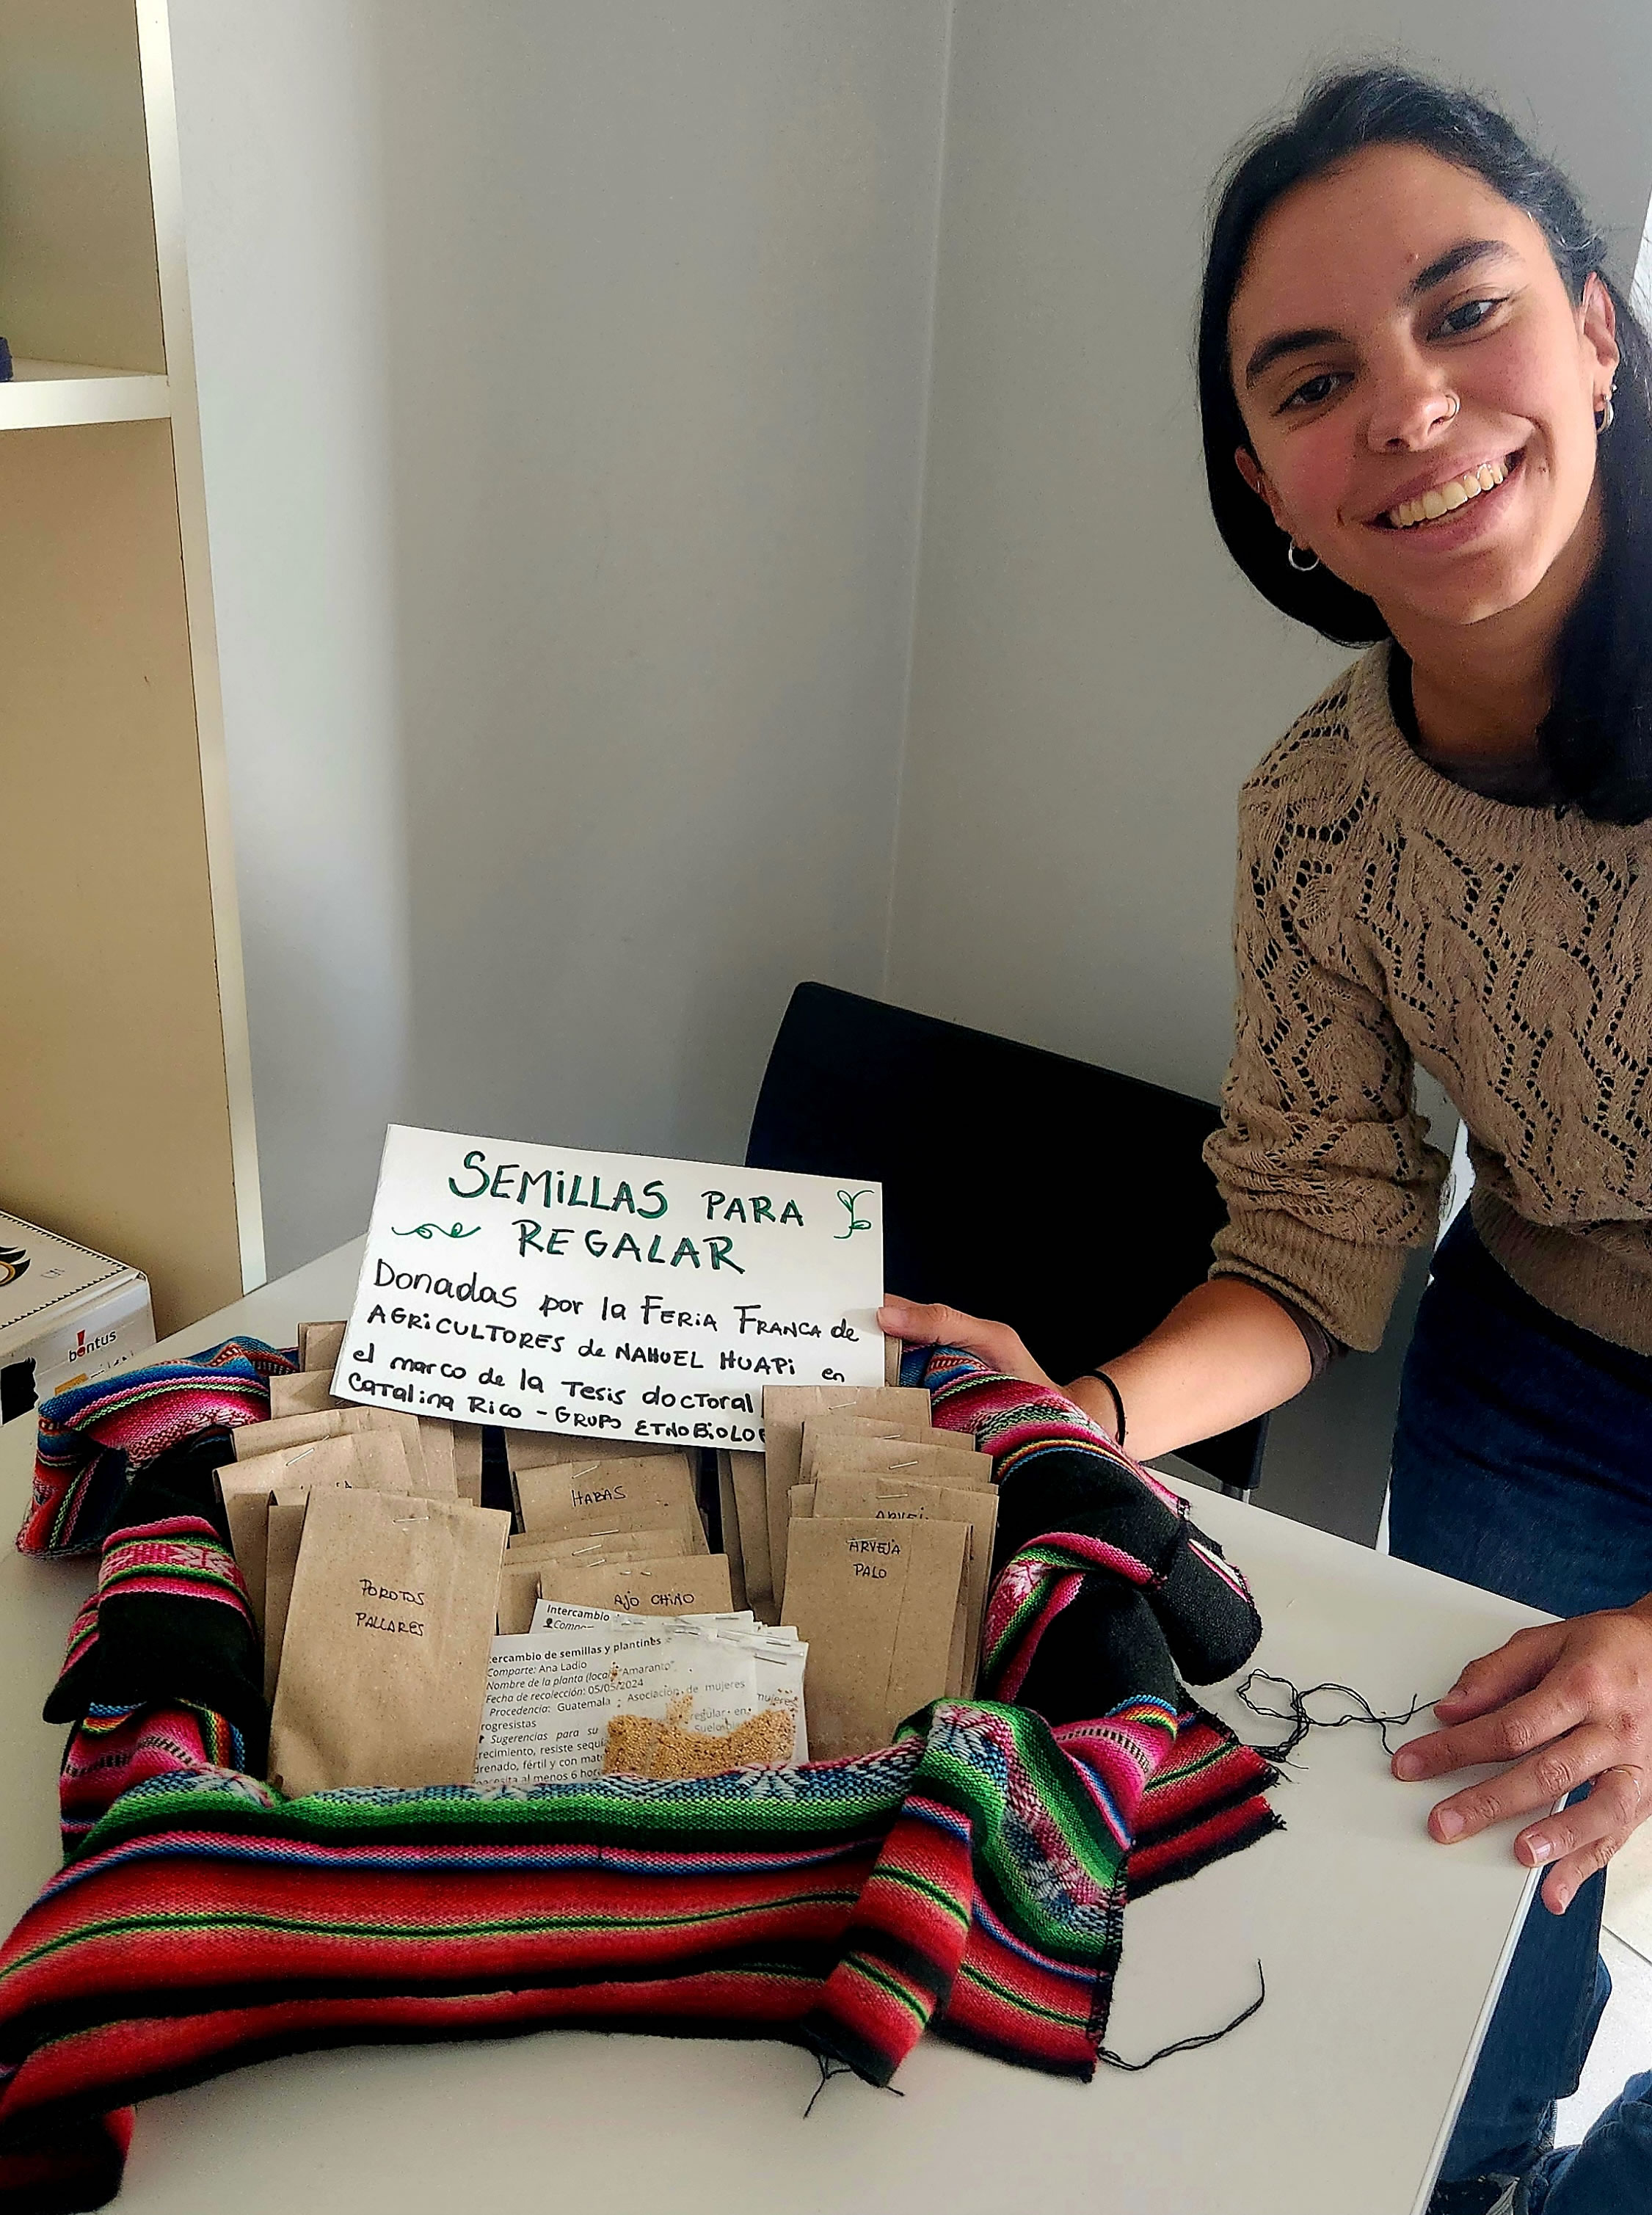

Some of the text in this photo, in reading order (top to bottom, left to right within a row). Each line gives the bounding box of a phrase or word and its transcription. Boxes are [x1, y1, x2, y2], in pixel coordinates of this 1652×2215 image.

[701, 1190, 804, 1227] PARA
[511, 1219, 746, 1274] REGALAR
[374, 1259, 517, 1308] Donadas
[539, 1295, 583, 1317] por
[601, 1296, 627, 1321] la
[830, 1318, 859, 1342] de
[578, 1338, 606, 1358] de
[616, 1342, 704, 1369] NAHUEL
[821, 1367, 845, 1383] en
[352, 1342, 375, 1364] el
[390, 1356, 467, 1380] marco
[478, 1367, 506, 1387] de
[520, 1368, 545, 1393] la
[561, 1381, 627, 1405] Tesis
[467, 1396, 523, 1419] Rico
[555, 1405, 622, 1429] GRUPO
[571, 1485, 626, 1507] HABAS
[849, 1538, 901, 1556] ARVEJA
[853, 1563, 887, 1579] PALO
[359, 1579, 425, 1606] POROTOS
[547, 1604, 611, 1622] Intercambio
[355, 1612, 424, 1637] PALLARES
[489, 1651, 542, 1664] ercambio
[544, 1650, 557, 1660] de
[559, 1645, 603, 1659] semillas
[604, 1645, 611, 1656] y
[487, 1661, 587, 1678] Comparte: Ana Ladio
[486, 1679, 525, 1691] Nombre
[528, 1678, 539, 1688] de
[542, 1676, 551, 1687] la
[553, 1673, 583, 1687] planta
[486, 1693, 514, 1704] Fecha
[516, 1692, 528, 1702] de
[588, 1678, 644, 1695] 05/05/2024
[490, 1703, 551, 1717] Procedencia:
[557, 1696, 611, 1712] Guatemala
[687, 1684, 699, 1694] de
[705, 1680, 746, 1693] mujeres
[481, 1720, 537, 1733] rogresistas
[490, 1732, 549, 1746] Sugerencias
[556, 1729, 580, 1742] para
[587, 1726, 599, 1736] su
[476, 1747, 536, 1761] recimiento,
[540, 1744, 573, 1756] resiste
[550, 1759, 556, 1770] y
[559, 1758, 578, 1767] con
[534, 1772, 569, 1783] menos
[571, 1770, 578, 1780] 6
